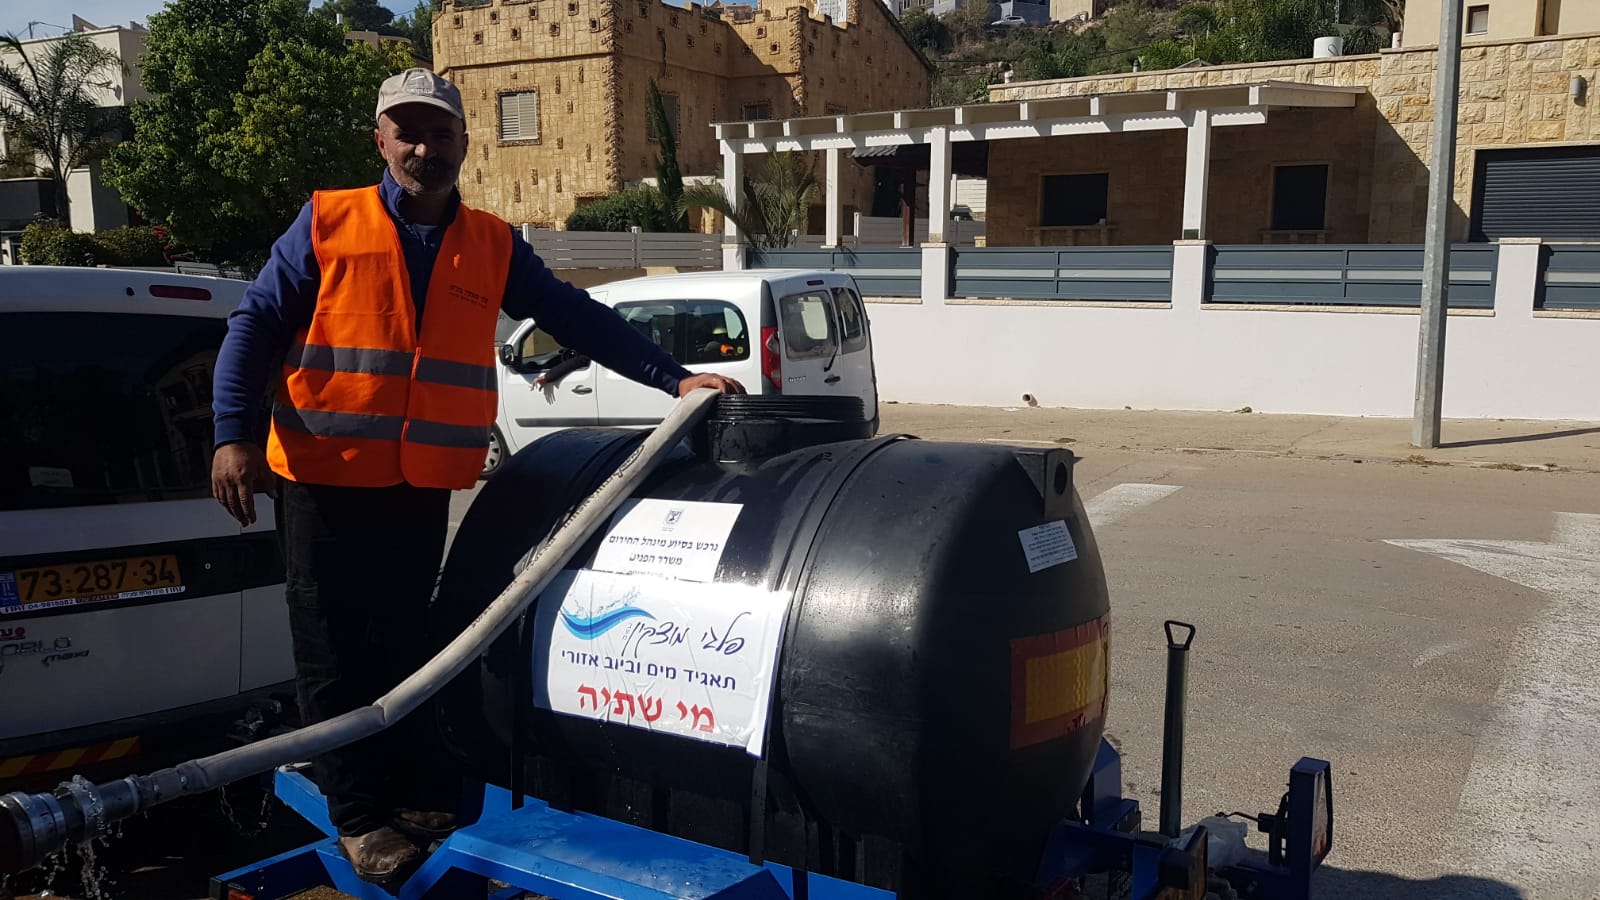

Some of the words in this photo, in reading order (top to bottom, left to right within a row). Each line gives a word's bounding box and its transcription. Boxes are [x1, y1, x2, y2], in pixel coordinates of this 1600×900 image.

[609, 535, 639, 546] החירום
[640, 536, 666, 548] מינהל
[667, 539, 693, 550] בסיוע
[696, 541, 719, 552] נרכש
[658, 555, 683, 566] משרד
[621, 621, 690, 659] מוצקין
[701, 611, 752, 656] פלגי
[0, 636, 72, 656] OBLO
[561, 649, 599, 667] אזורי
[604, 656, 641, 674] וביוב
[647, 663, 677, 680] מים
[684, 669, 736, 690] תאגיד
[577, 683, 663, 722] שתיה
[676, 700, 715, 733] מי
